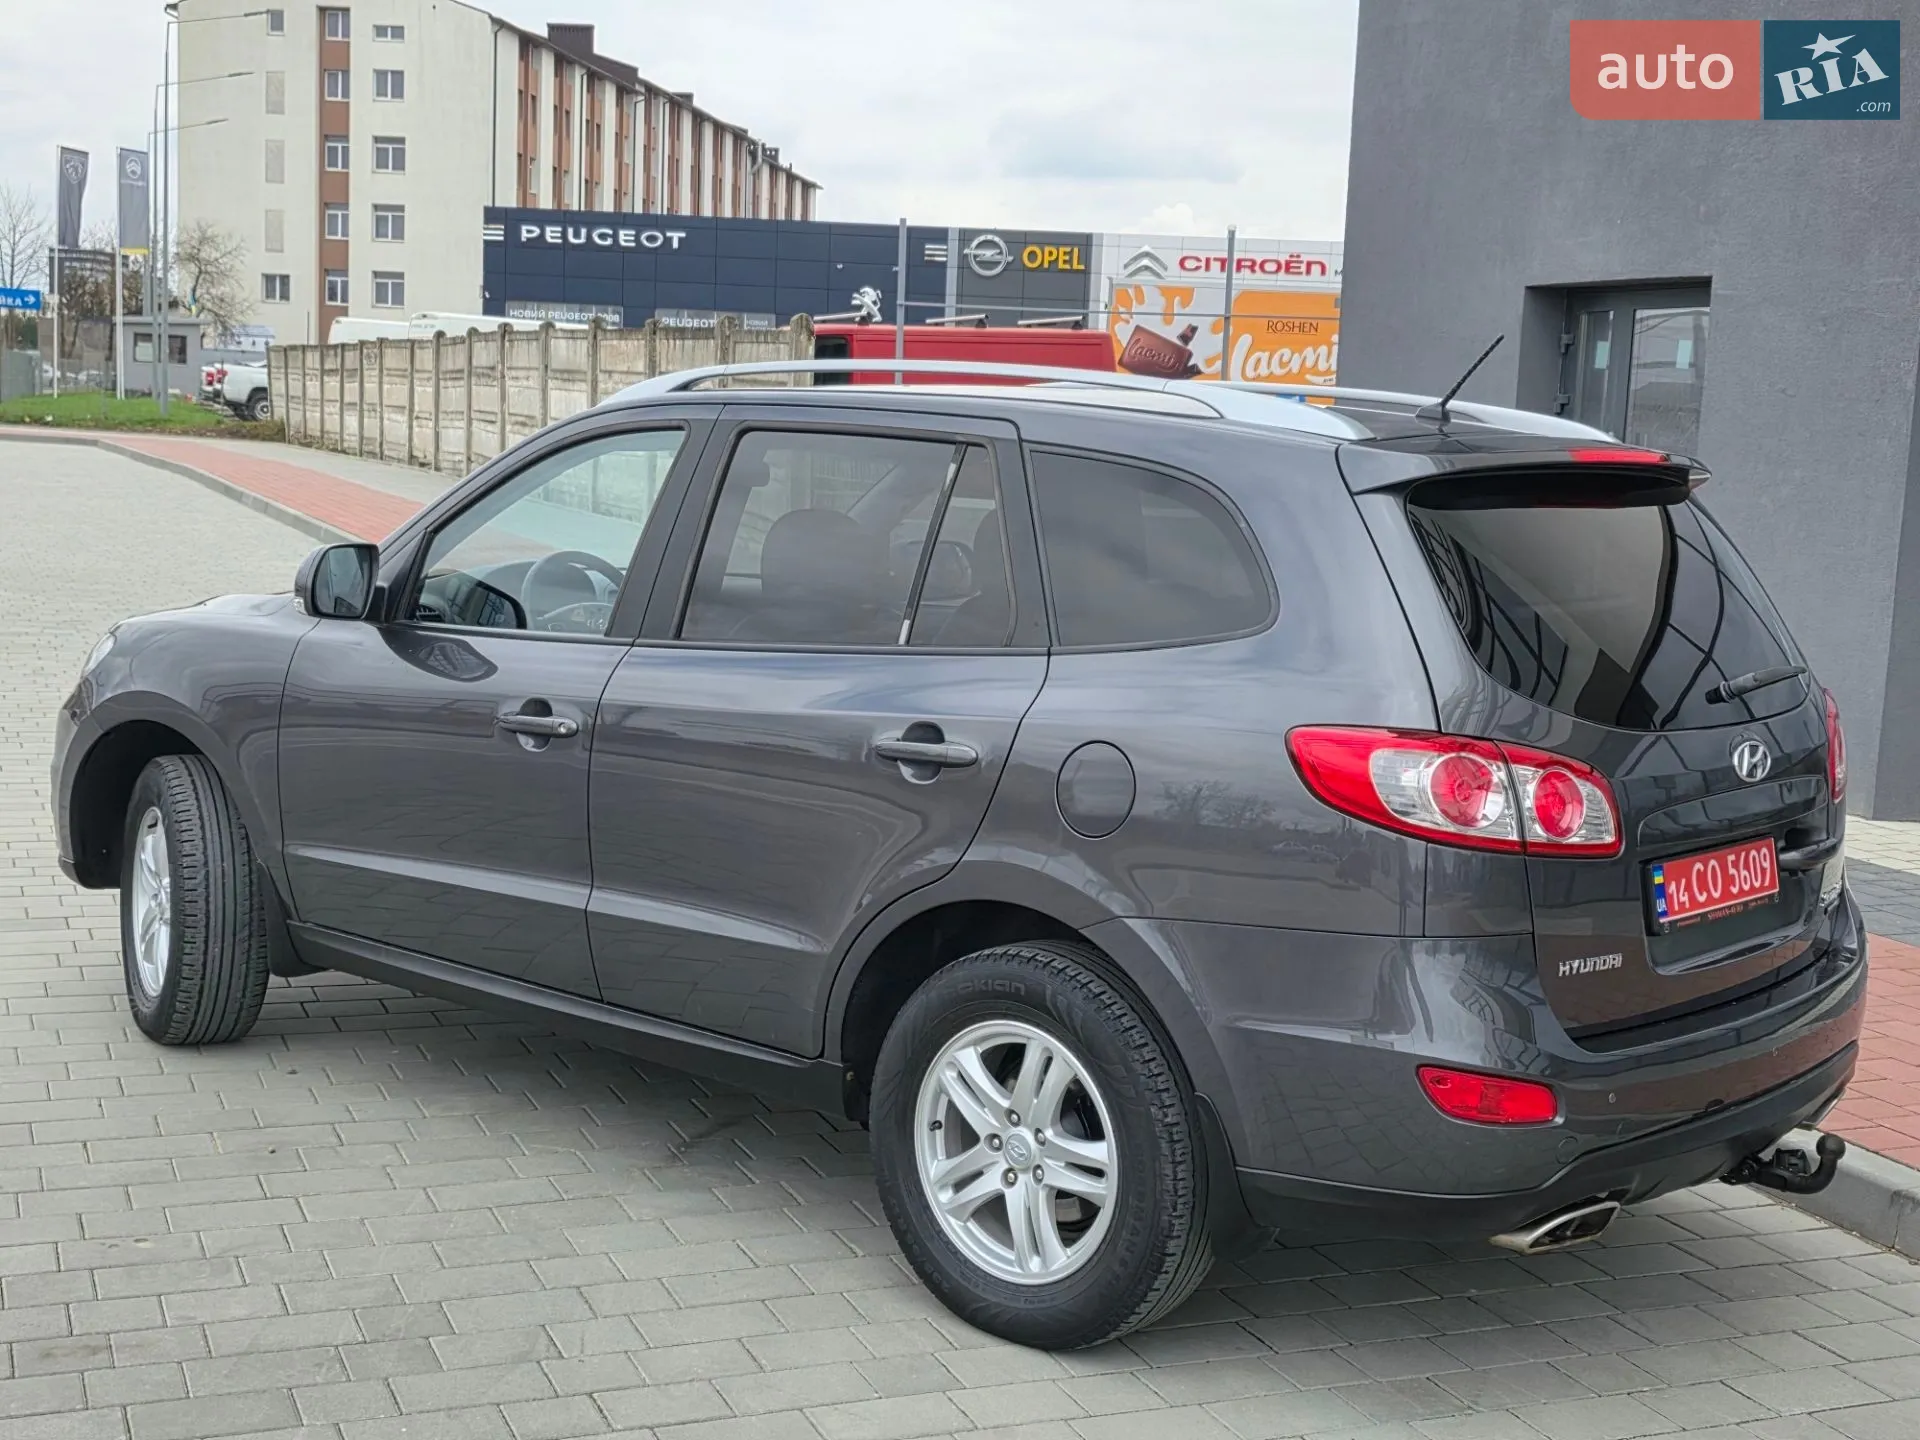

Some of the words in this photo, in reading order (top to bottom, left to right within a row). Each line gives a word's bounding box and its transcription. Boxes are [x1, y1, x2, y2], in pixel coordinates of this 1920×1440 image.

[520, 224, 686, 249] PEUGEOT
[1022, 245, 1086, 270] OPEL
[547, 311, 593, 322] PEUGEOT
[661, 316, 716, 329] PEUGEOT
[1266, 320, 1320, 335] ROSHEN
[1726, 846, 1771, 895] 5609
[1558, 953, 1622, 977] HYUNDAI
